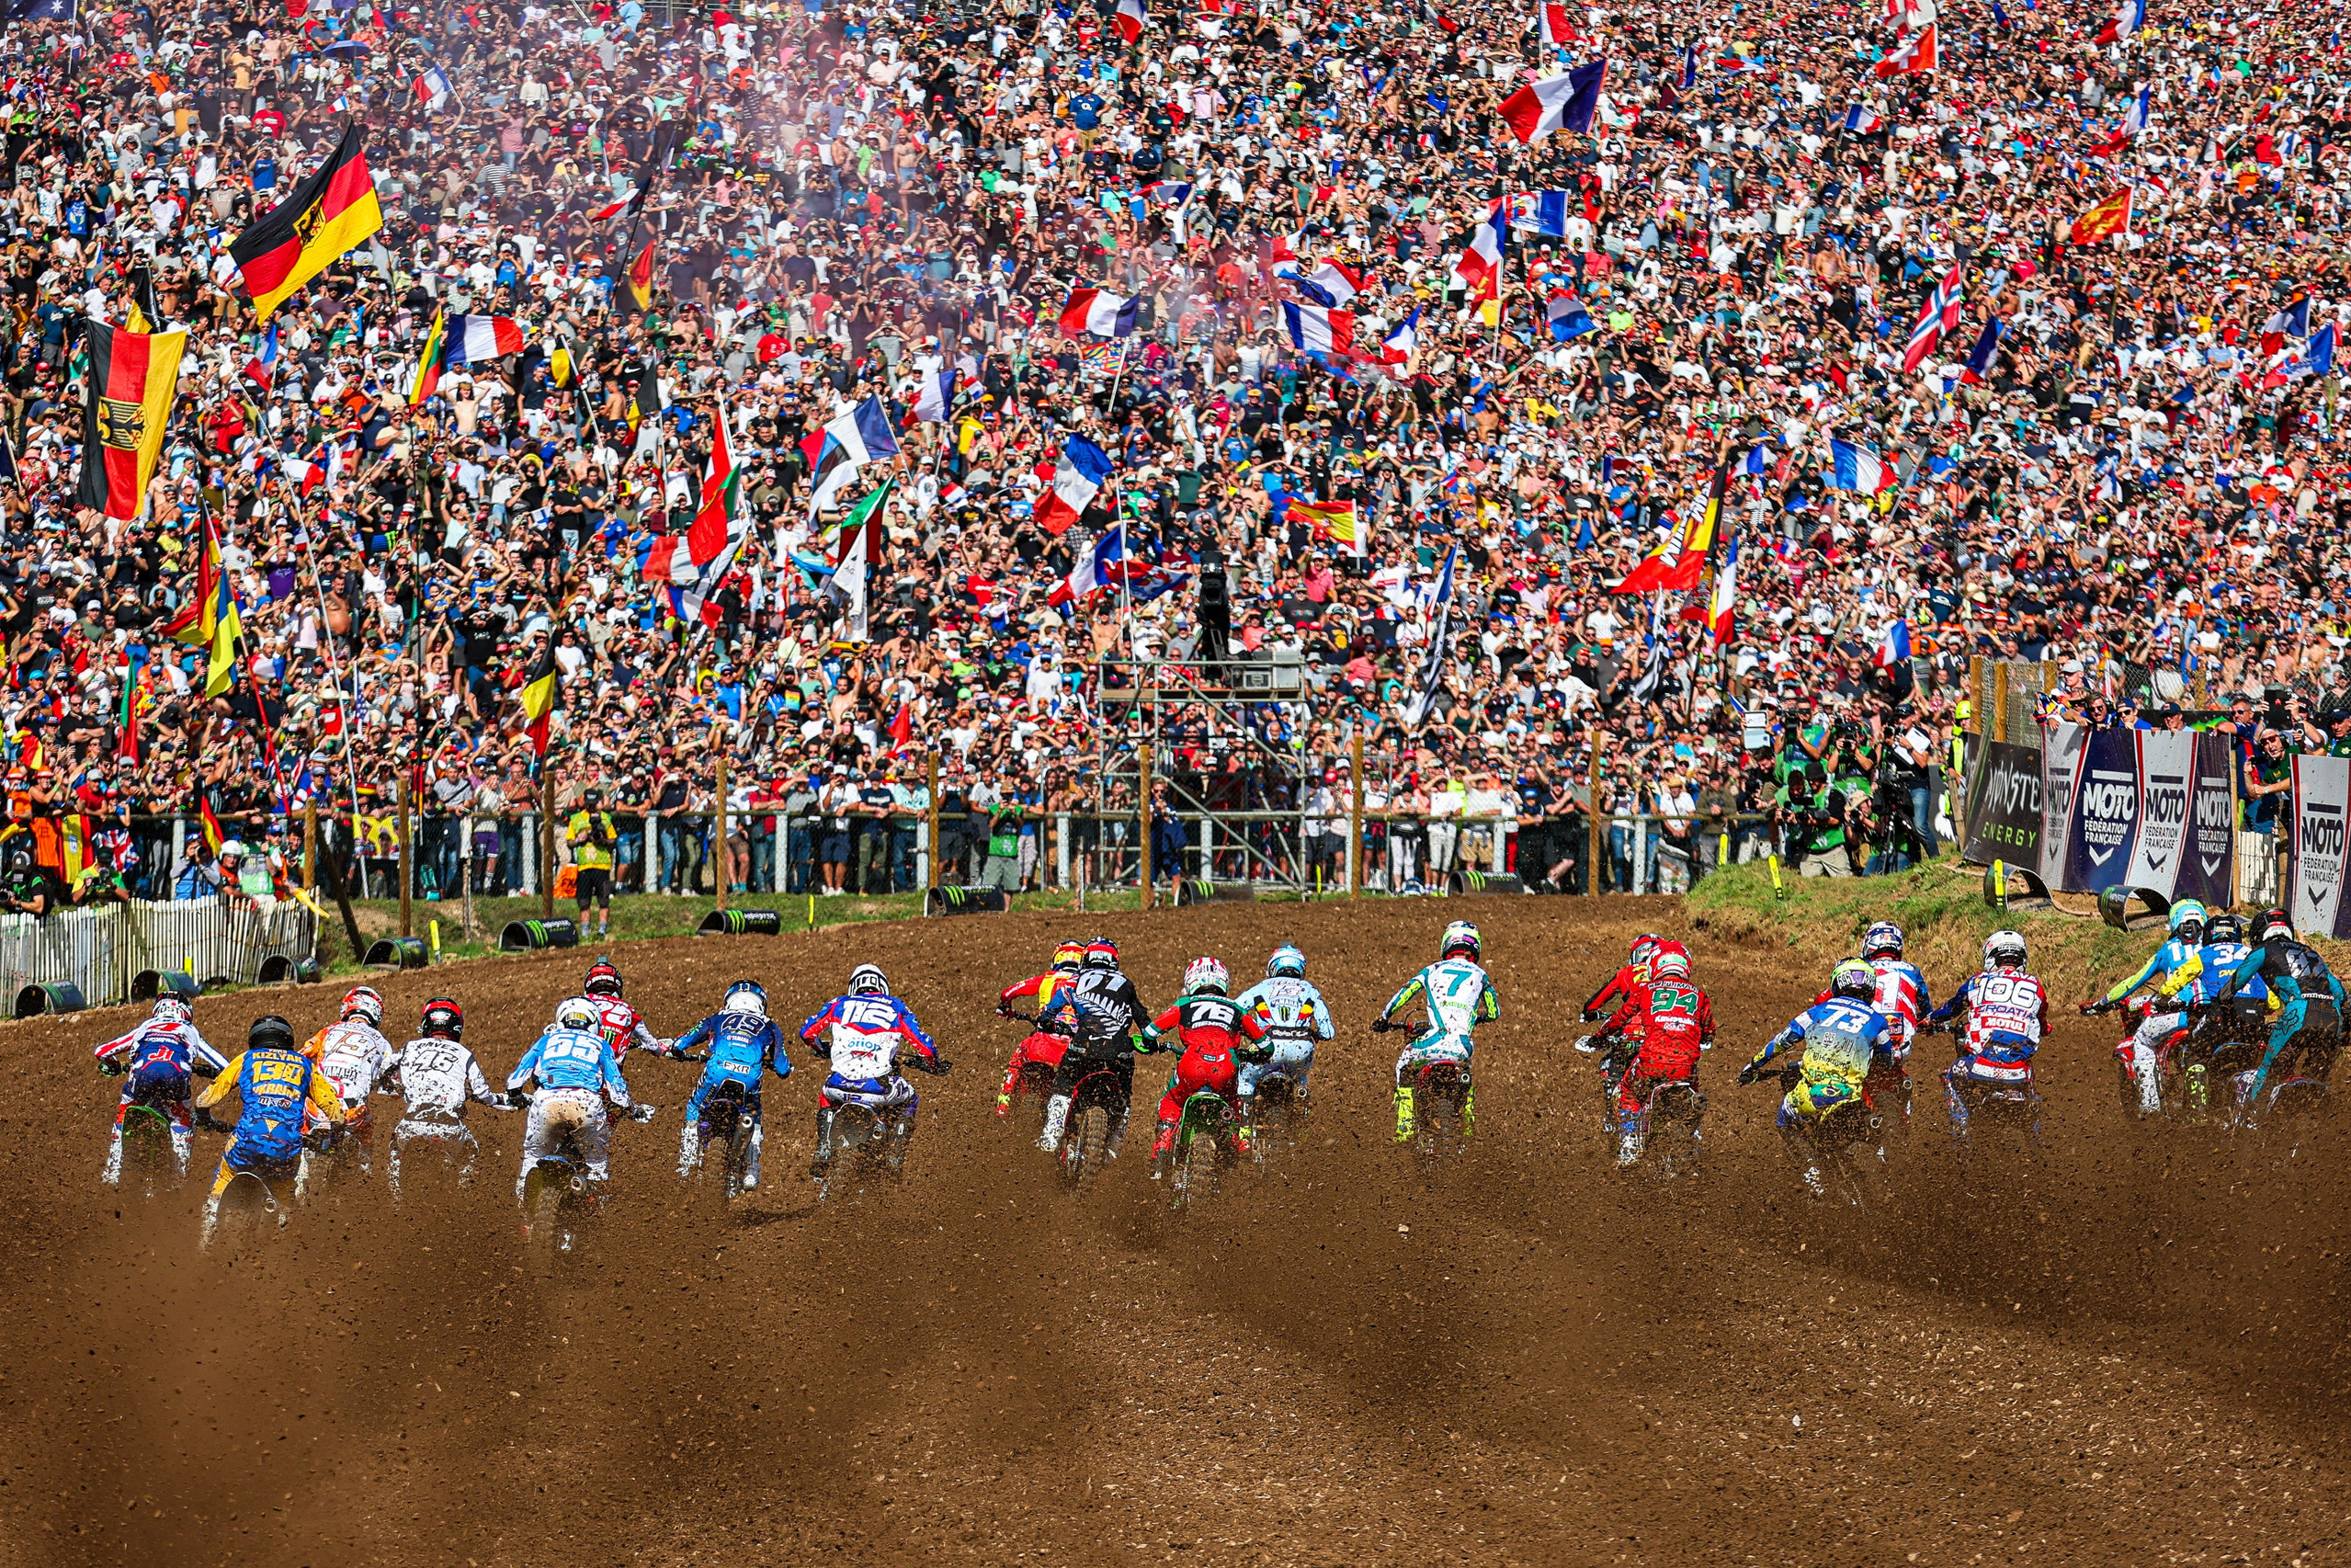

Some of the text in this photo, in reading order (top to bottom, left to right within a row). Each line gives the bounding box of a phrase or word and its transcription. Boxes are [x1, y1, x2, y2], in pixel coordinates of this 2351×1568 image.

[2083, 781, 2135, 821] MOTO
[2145, 788, 2186, 824] MOTO
[2197, 790, 2231, 827] MOTO
[1982, 821, 2037, 848] ENERGY
[2084, 817, 2129, 835] FÉDÉRATION
[2301, 816, 2345, 857] MOTO
[2084, 832, 2124, 846] FRANÇAISE
[2213, 944, 2253, 966] 34
[1442, 969, 1472, 996] 7
[1976, 977, 2039, 1009] 106
[1190, 1001, 1235, 1025] 76
[1651, 988, 1698, 1016] 94
[1852, 1001, 1875, 1015] LIMA
[1979, 1004, 2034, 1019] CROATIA
[721, 1014, 766, 1036] 49
[841, 1000, 898, 1030] 112
[1191, 1020, 1230, 1031] MEXICO
[1820, 1004, 1871, 1034] 73
[1985, 1017, 2026, 1030] MOTUL
[542, 1033, 603, 1064] 55
[847, 1038, 880, 1051] orion
[252, 1051, 303, 1063] KIZLYAK
[412, 1050, 459, 1074] 46
[723, 1061, 750, 1074] FXR
[252, 1061, 304, 1086] 130
[324, 1066, 358, 1080] YAMAHA
[252, 1084, 301, 1102] UKRAINE
